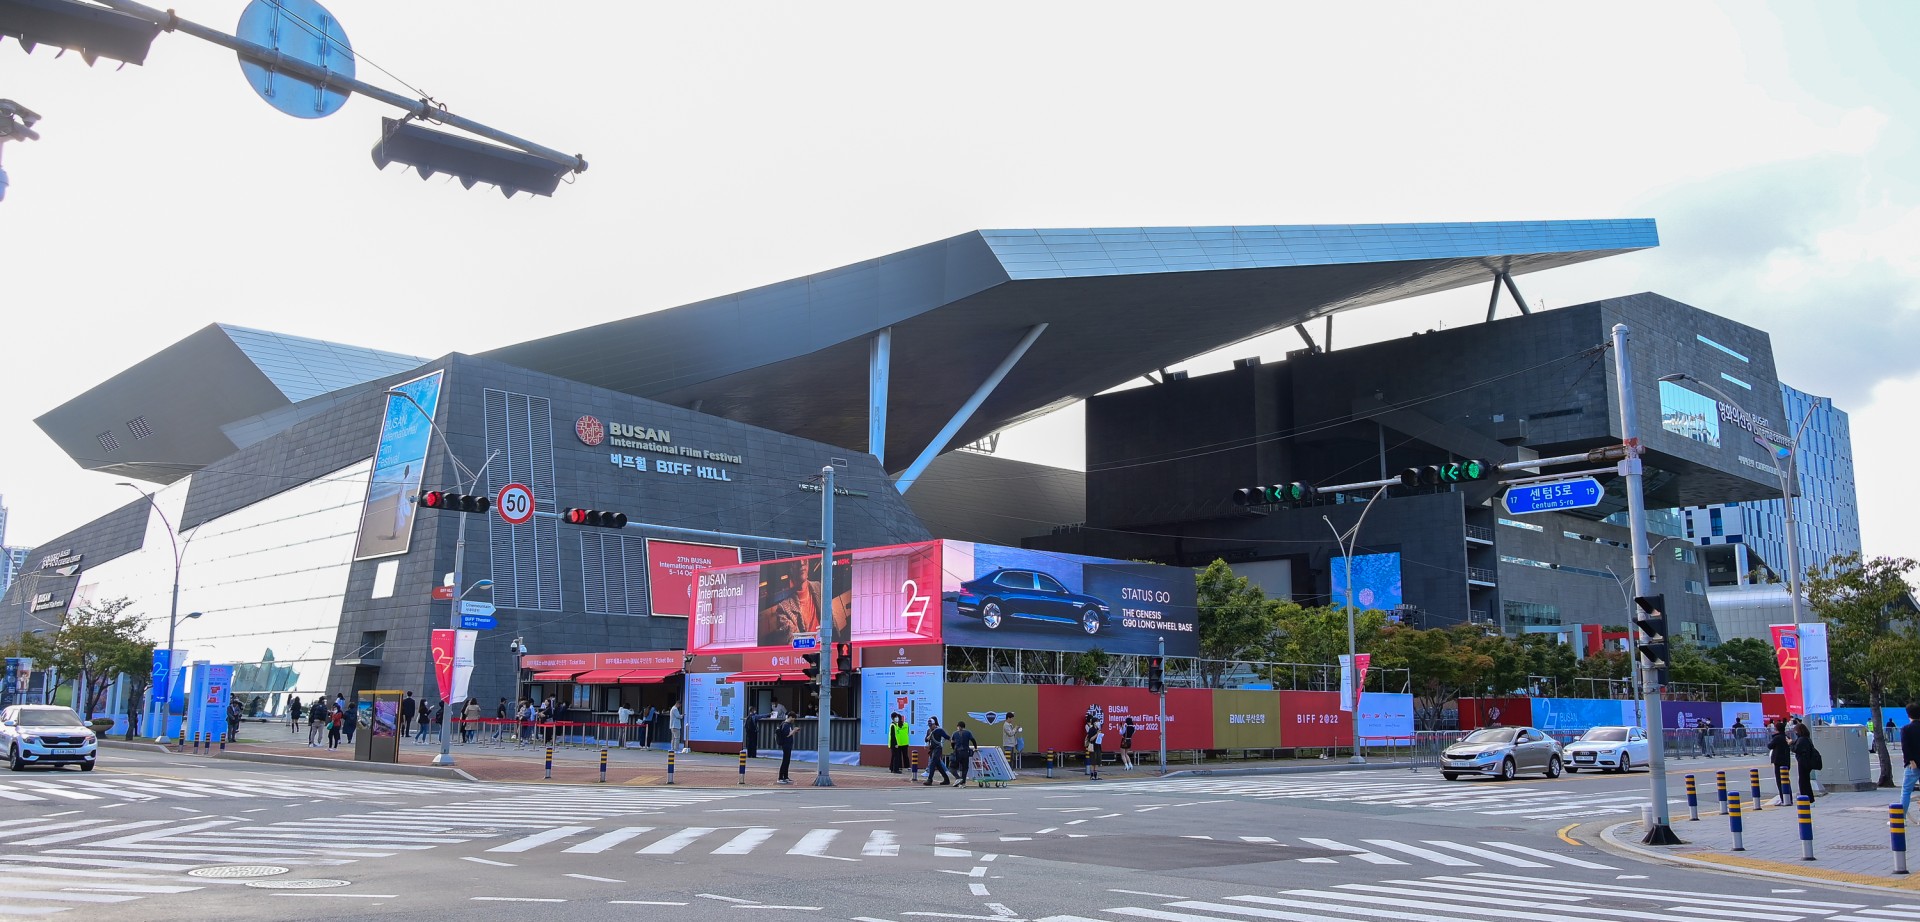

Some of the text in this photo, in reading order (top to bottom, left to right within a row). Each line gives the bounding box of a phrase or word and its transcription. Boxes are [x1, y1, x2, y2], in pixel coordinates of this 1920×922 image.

[609, 422, 671, 443] BUSAN
[610, 436, 742, 464] International Film Festival
[610, 453, 731, 481] 비프힐 BIFF HILL
[1530, 484, 1595, 501] 센텀5로 19
[506, 494, 526, 513] 50
[1510, 496, 1518, 504] 17
[1531, 499, 1574, 509] Centum 5-ro
[659, 561, 695, 570] International
[690, 557, 711, 565] BUSAN
[699, 573, 727, 586] BUSAN
[697, 584, 743, 600] International
[1121, 587, 1170, 603] STATUS GO
[697, 601, 713, 611] Film
[900, 580, 930, 634] 27
[696, 611, 726, 625] Festival
[1122, 608, 1162, 620] THE GENESIS
[1122, 618, 1193, 632] G90 LONG WHEEL BASE
[432, 647, 453, 674] 27
[1776, 646, 1798, 680] 27
[153, 662, 169, 682] 27
[1108, 705, 1129, 713] BUSAN
[1142, 714, 1154, 722] Film
[1154, 714, 1175, 722] Feival
[1245, 714, 1265, 724] 부산은행
[1297, 714, 1339, 724] BIFF 2022
[1146, 723, 1158, 731] 2022
